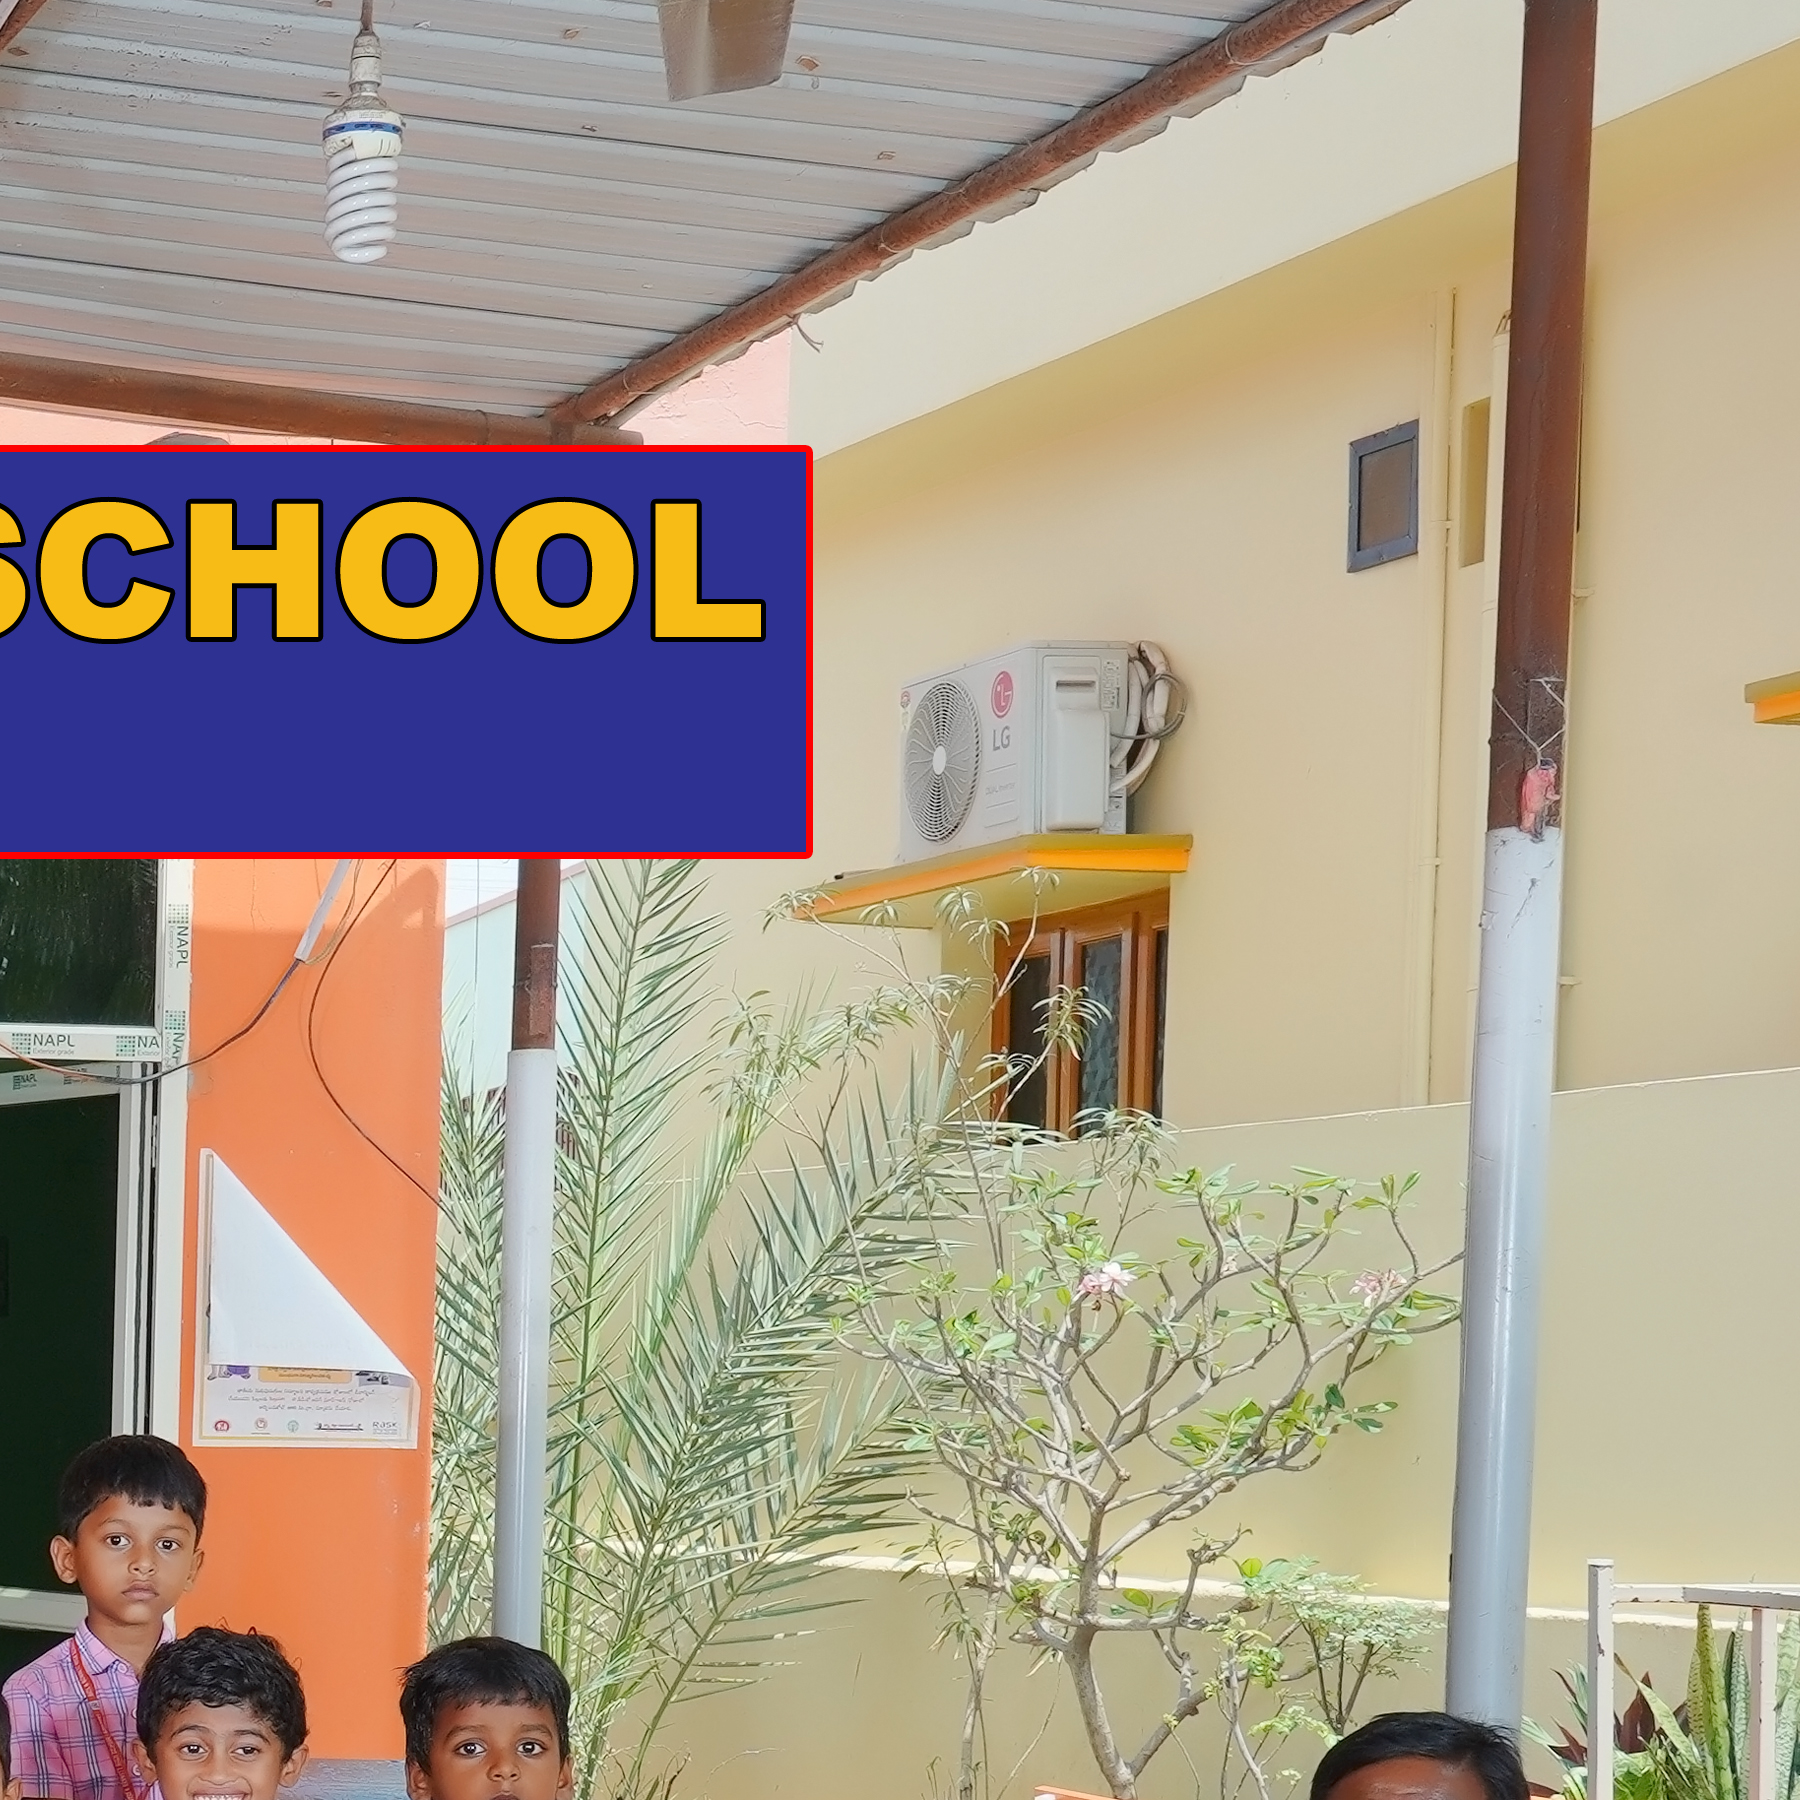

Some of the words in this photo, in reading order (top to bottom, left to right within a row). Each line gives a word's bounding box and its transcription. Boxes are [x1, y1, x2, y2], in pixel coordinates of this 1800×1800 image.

[993, 725, 1010, 751] LG
[176, 926, 189, 969] NAPL
[33, 1034, 75, 1048] NAPL
[137, 1036, 159, 1048] NA
